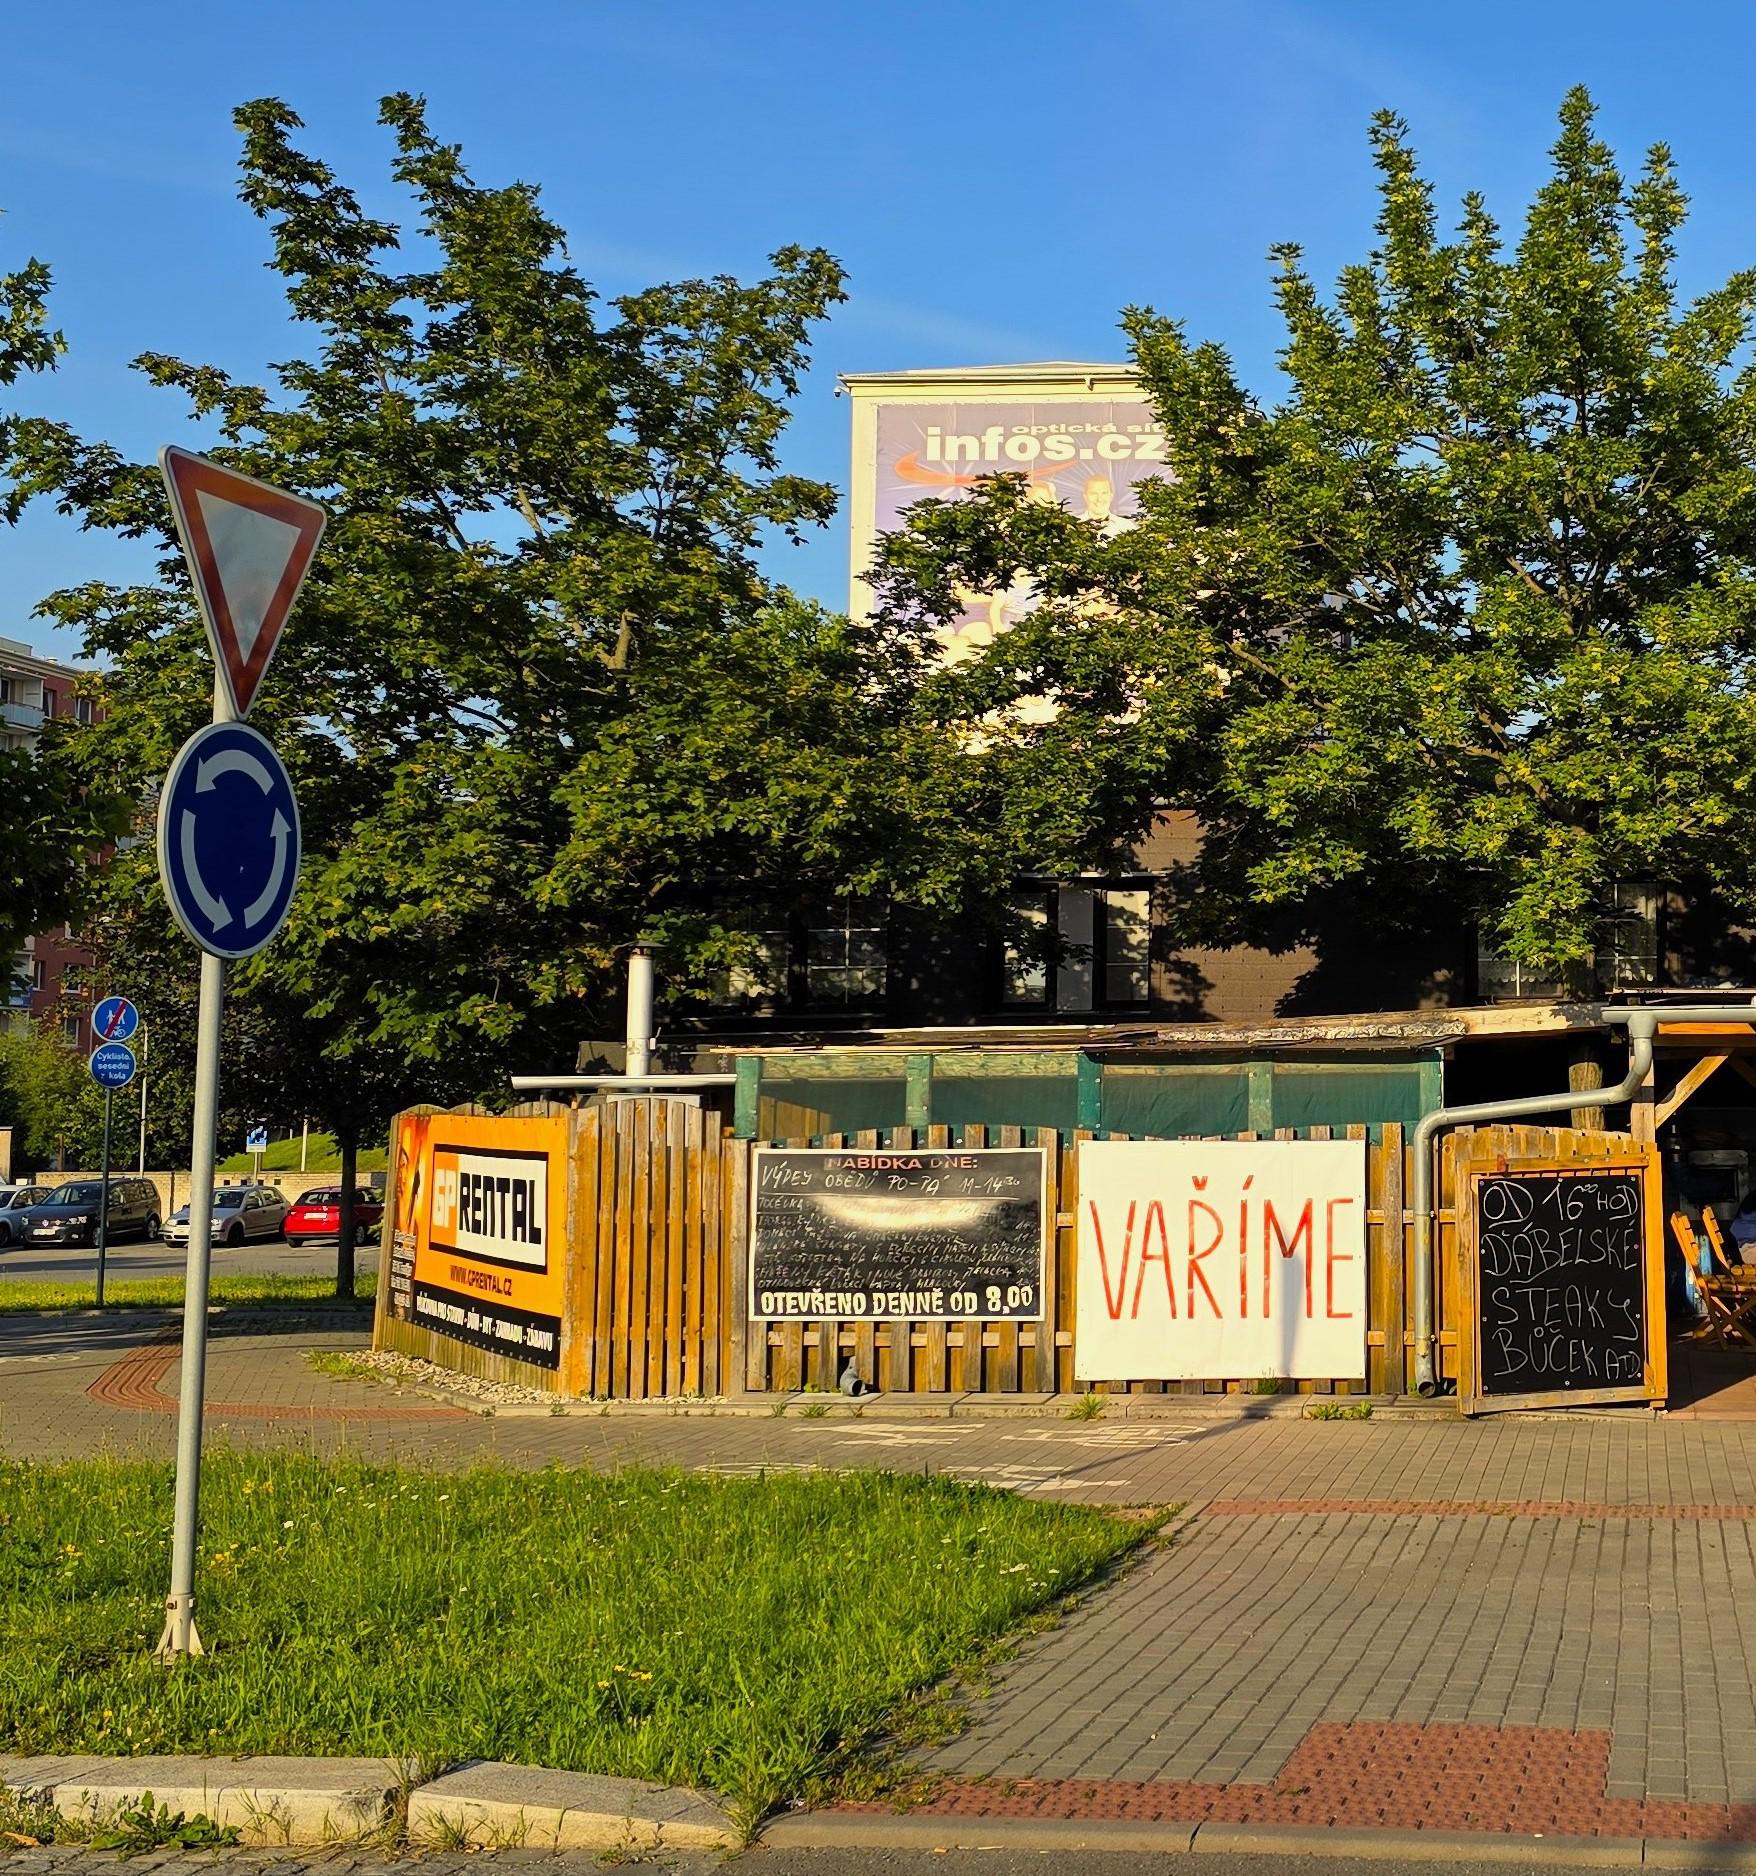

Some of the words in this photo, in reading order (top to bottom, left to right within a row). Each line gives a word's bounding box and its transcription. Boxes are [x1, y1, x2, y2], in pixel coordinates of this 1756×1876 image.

[926, 426, 1166, 462] infos.cz
[1011, 422, 1118, 436] optická
[109, 1072, 126, 1080] kola
[827, 1154, 921, 1170] NABÍDKA
[459, 1172, 541, 1245] RENTAL
[1483, 1181, 1533, 1228] OD
[1597, 1185, 1638, 1220] HOD
[1089, 1174, 1353, 1319] VAŘÍME
[761, 1288, 866, 1315] OTEVŘENO
[872, 1287, 943, 1315] DENNĚ
[950, 1291, 977, 1313] OD
[986, 1285, 1033, 1315] 8,00
[1492, 1285, 1638, 1341] STEAKY
[1492, 1326, 1598, 1376] BŮČEK
[1605, 1348, 1641, 1379] ATD
